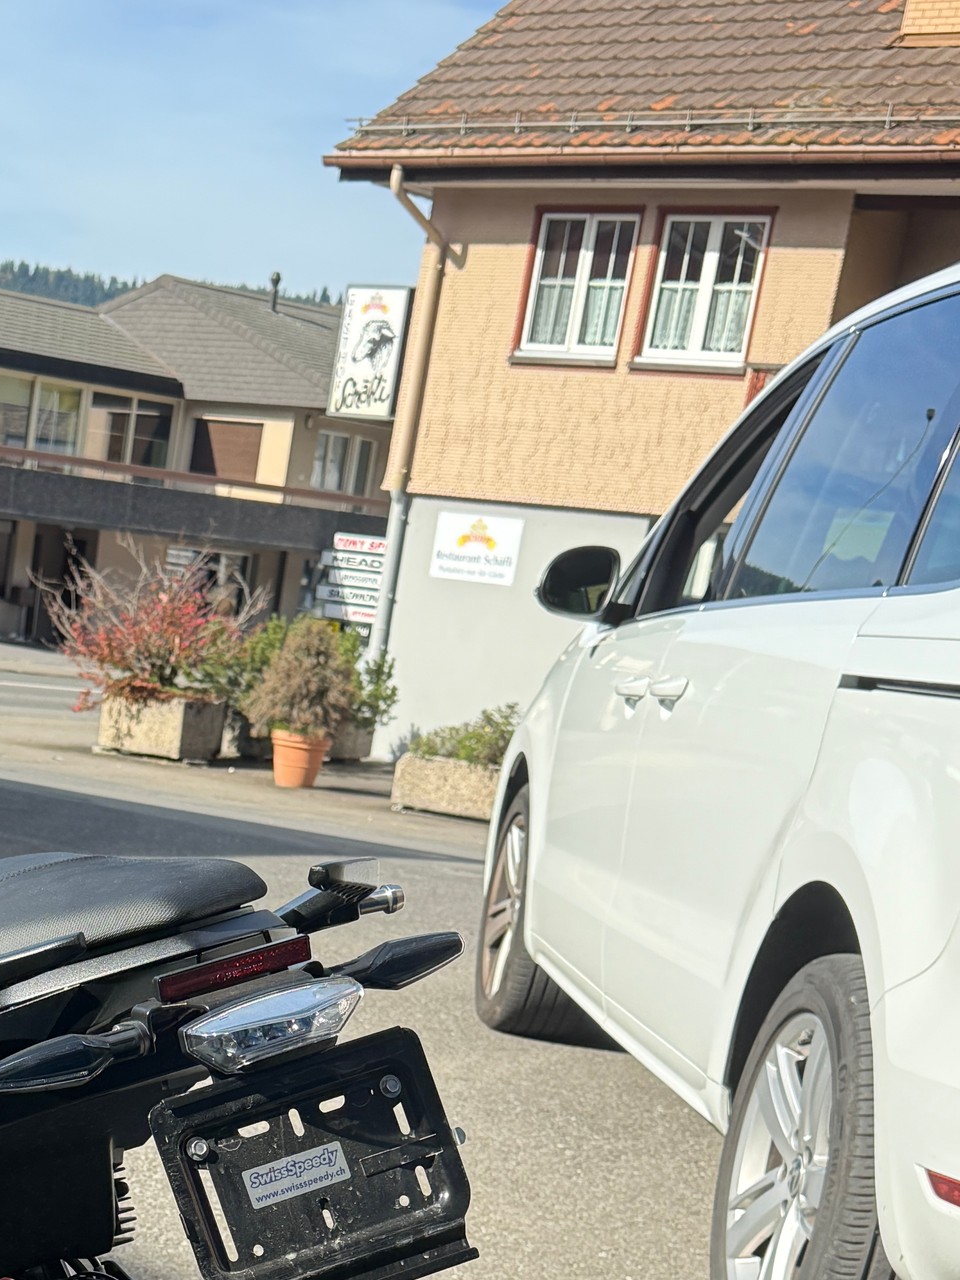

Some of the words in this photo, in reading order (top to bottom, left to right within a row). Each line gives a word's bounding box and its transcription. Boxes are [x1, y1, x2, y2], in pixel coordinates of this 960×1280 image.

[333, 556, 384, 569] HEAD
[436, 550, 482, 563] Restaurant
[249, 1147, 338, 1188] SwissSpeedy
[255, 1167, 346, 1203] www.swissspeedy.ch
